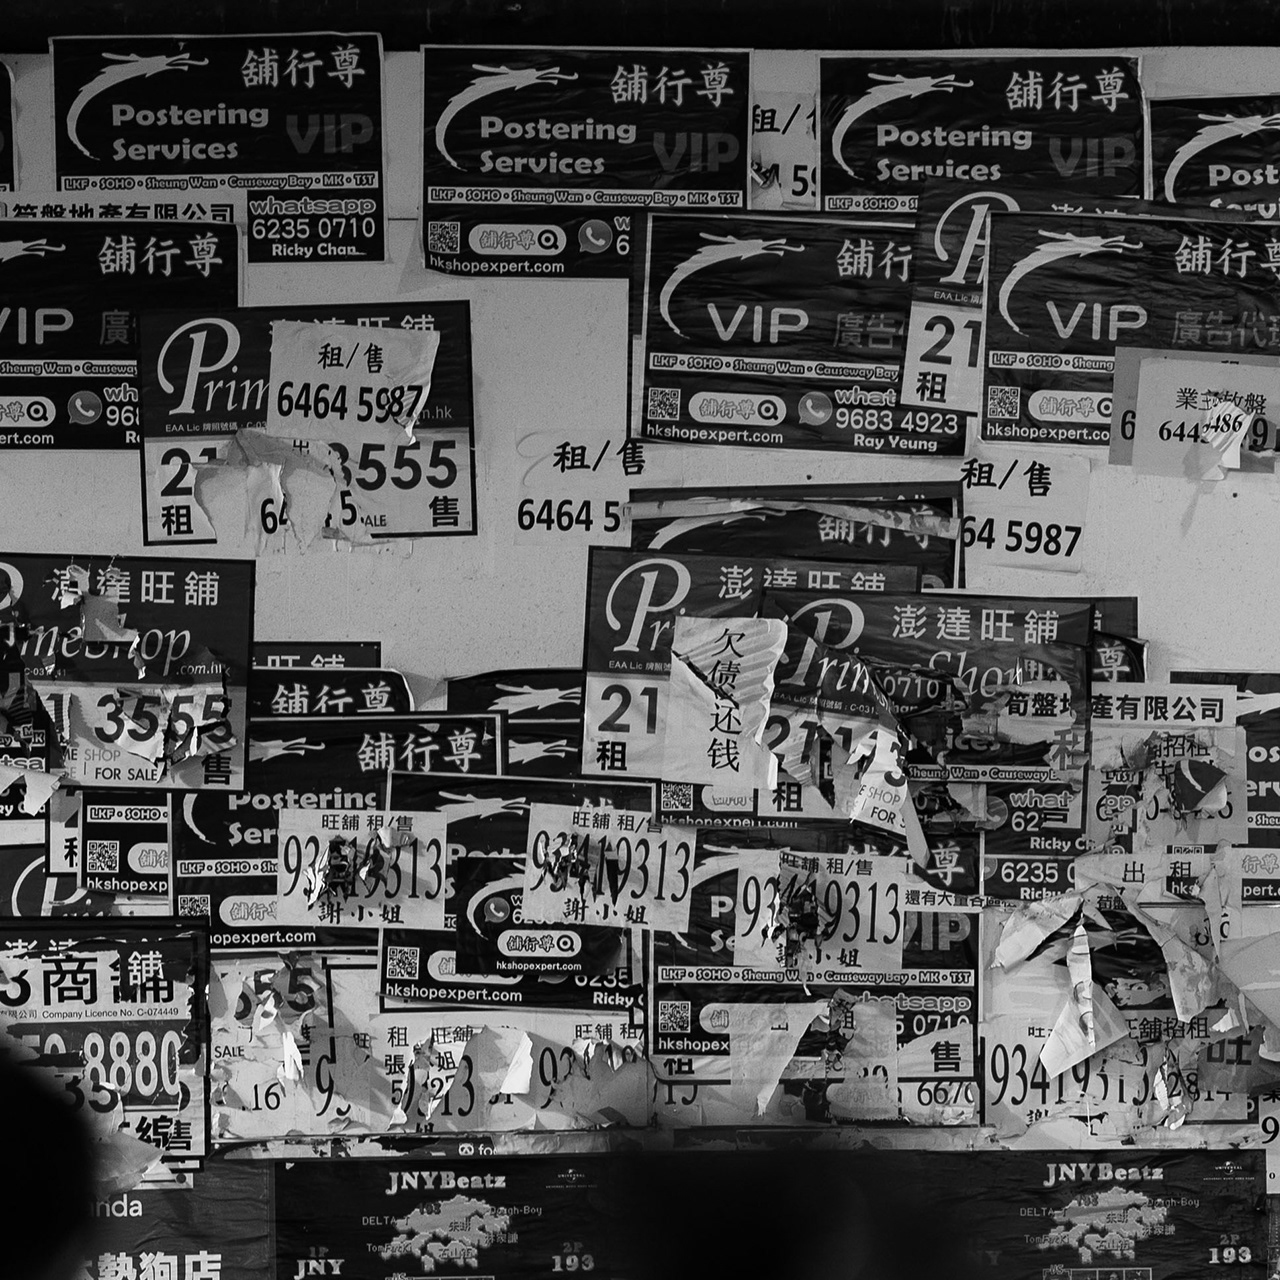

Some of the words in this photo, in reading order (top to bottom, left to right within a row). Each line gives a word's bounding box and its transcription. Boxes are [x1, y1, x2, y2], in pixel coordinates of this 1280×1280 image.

[240, 43, 367, 89] 舖行尊
[111, 105, 269, 129] Postering
[112, 139, 238, 162] Services
[65, 178, 89, 191] LKF
[100, 177, 134, 190] SOHO
[145, 177, 187, 190] Sheung
[191, 176, 217, 189] Wan
[227, 175, 284, 190] Causeway
[288, 174, 312, 189] Bay
[323, 174, 342, 187] MK
[353, 174, 375, 187] TST
[250, 198, 375, 217] whatsapp
[253, 219, 309, 239] 6235
[319, 219, 375, 239] 0710
[98, 235, 223, 277] 舖行尊
[272, 243, 314, 258] Ricky
[318, 243, 357, 257] Chan
[430, 255, 564, 274] hkshopexpert.com
[707, 303, 808, 342] VIP
[318, 343, 384, 373] 租/售
[277, 386, 347, 422] 6464
[646, 422, 784, 444] hkshopexpert.com
[835, 409, 893, 431] 9683
[900, 411, 958, 433] 4923
[854, 434, 881, 451] Ray
[885, 435, 937, 454] Yeung
[554, 439, 646, 475] 租/售
[961, 458, 1053, 498] 租/售
[518, 498, 593, 532] 6464
[1004, 520, 1083, 558] 5987
[892, 605, 1059, 644] 澎達旺舖
[319, 901, 401, 925] 謝小姐
[386, 982, 522, 1003] hkshopexpert.com
[42, 1010, 81, 1020] Company
[84, 1009, 118, 1019] Licence
[120, 1008, 135, 1018] No.
[137, 1007, 179, 1018] C-074449
[386, 1171, 506, 1195] JNYBeatz
[294, 1259, 345, 1280] JNY
[552, 1254, 595, 1272] 193
